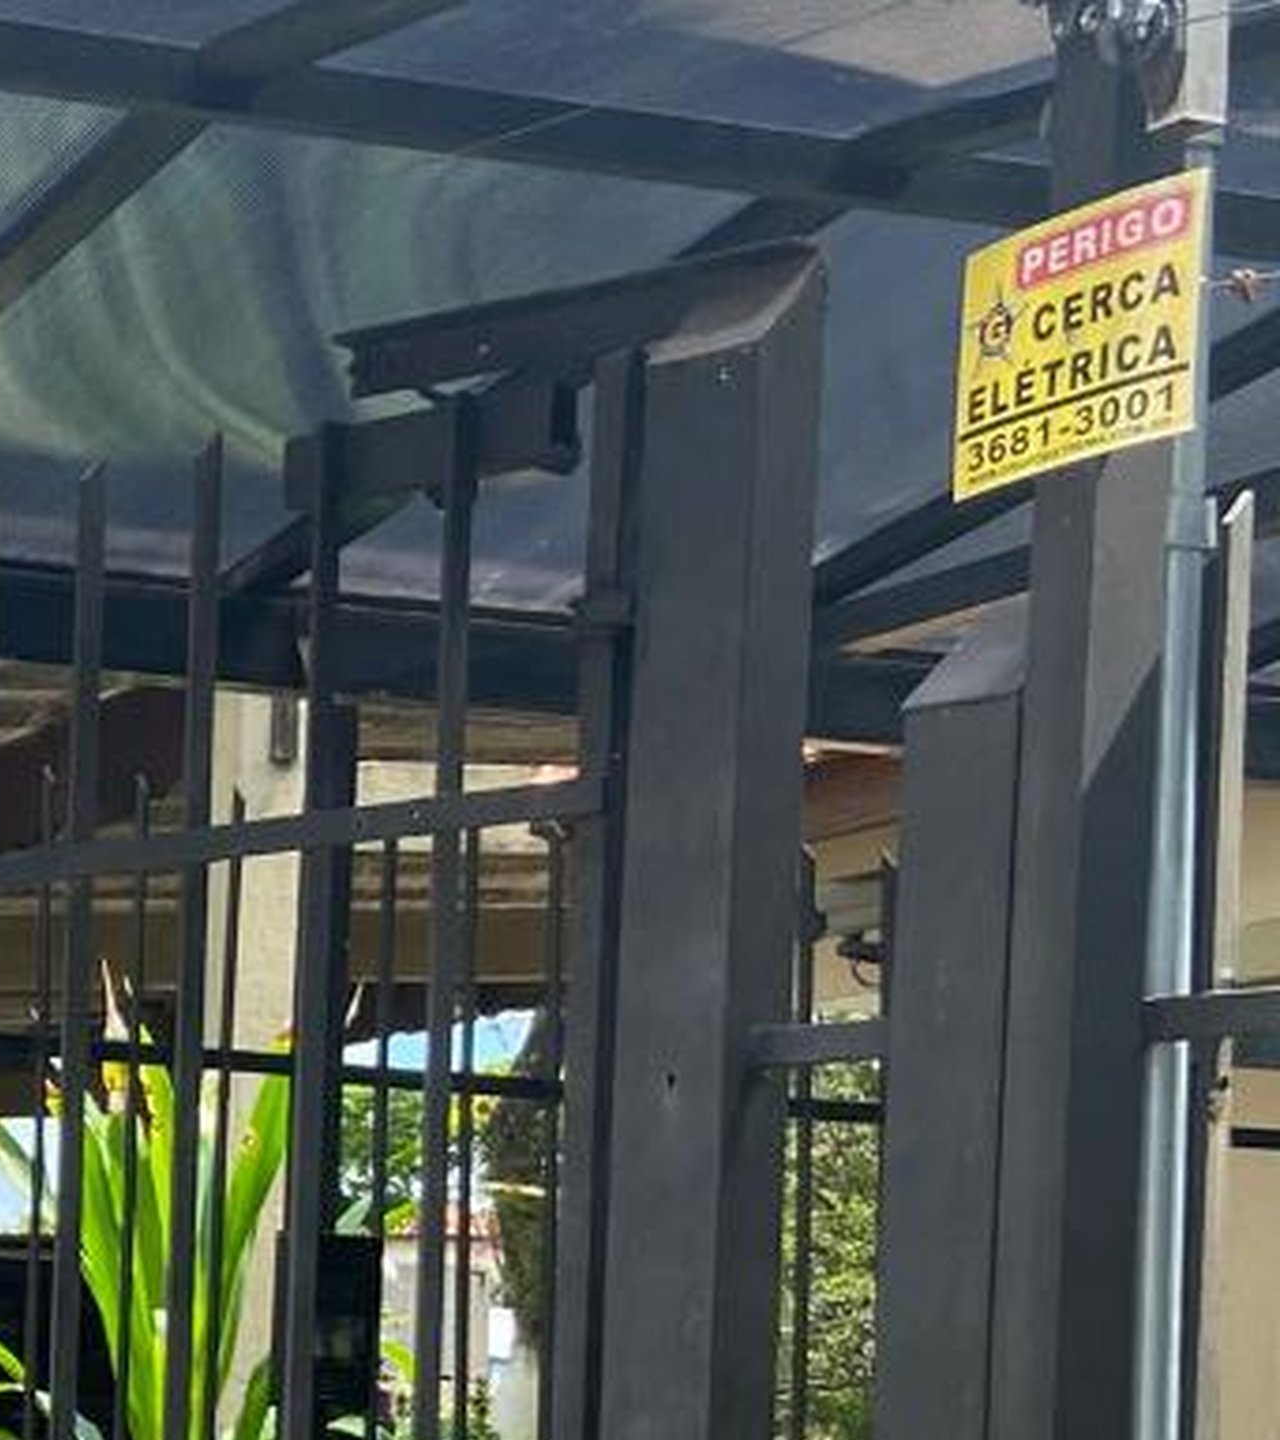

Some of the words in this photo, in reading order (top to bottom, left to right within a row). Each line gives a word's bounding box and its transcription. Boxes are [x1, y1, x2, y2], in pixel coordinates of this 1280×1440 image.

[1021, 198, 1186, 284] PERIGO
[1032, 262, 1181, 342] CERCA
[967, 325, 1176, 425] ELÉTRICA
[968, 382, 1175, 472] 3681-3001
